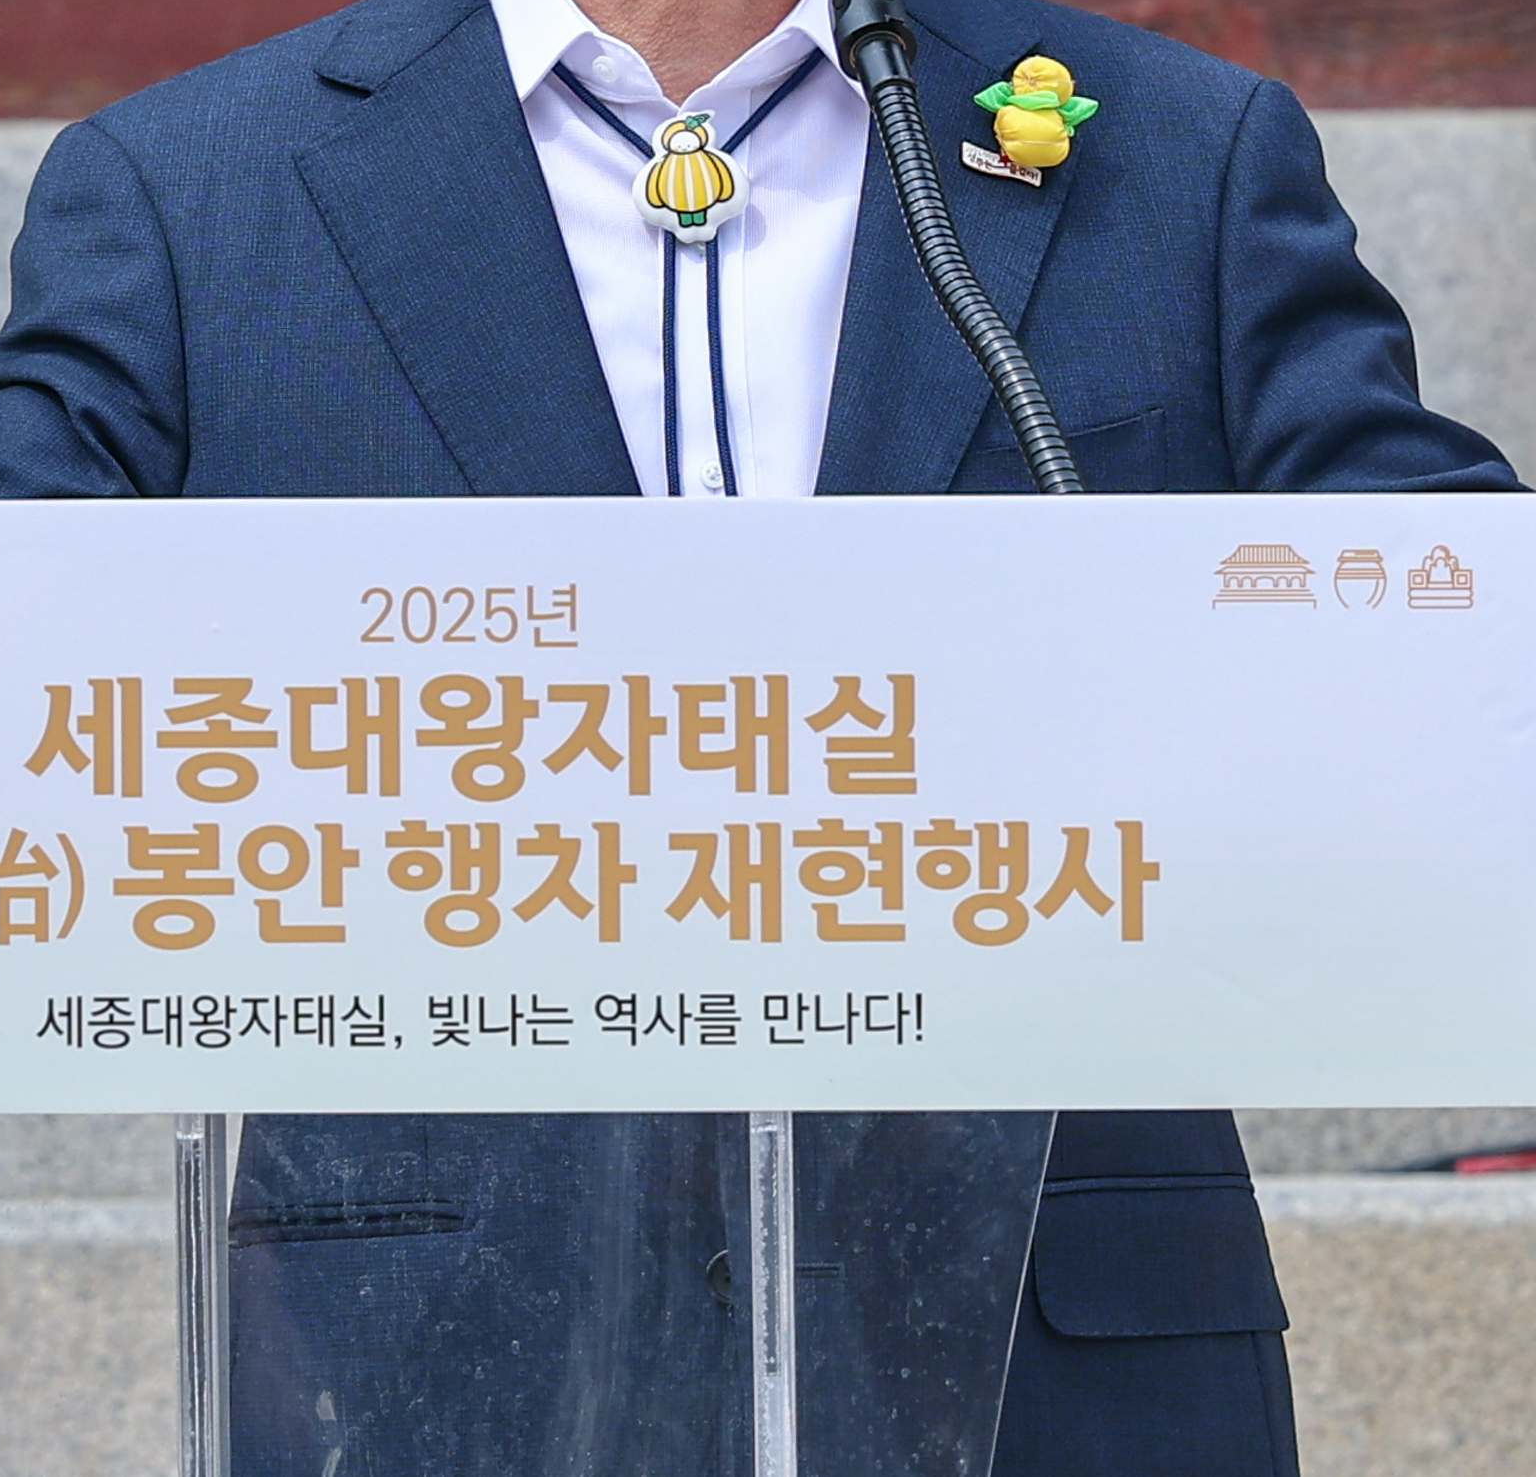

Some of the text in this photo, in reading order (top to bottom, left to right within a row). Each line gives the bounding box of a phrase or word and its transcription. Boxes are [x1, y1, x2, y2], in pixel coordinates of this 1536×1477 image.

[360, 583, 580, 648] 2025년
[23, 673, 919, 803] 세종대왕자태실
[112, 822, 361, 951] 봉안
[385, 819, 638, 948] 행차
[664, 818, 1162, 947] 재현행사
[36, 991, 925, 1050] 세종대왕자태실, 빛나는 역사를 만나다!
